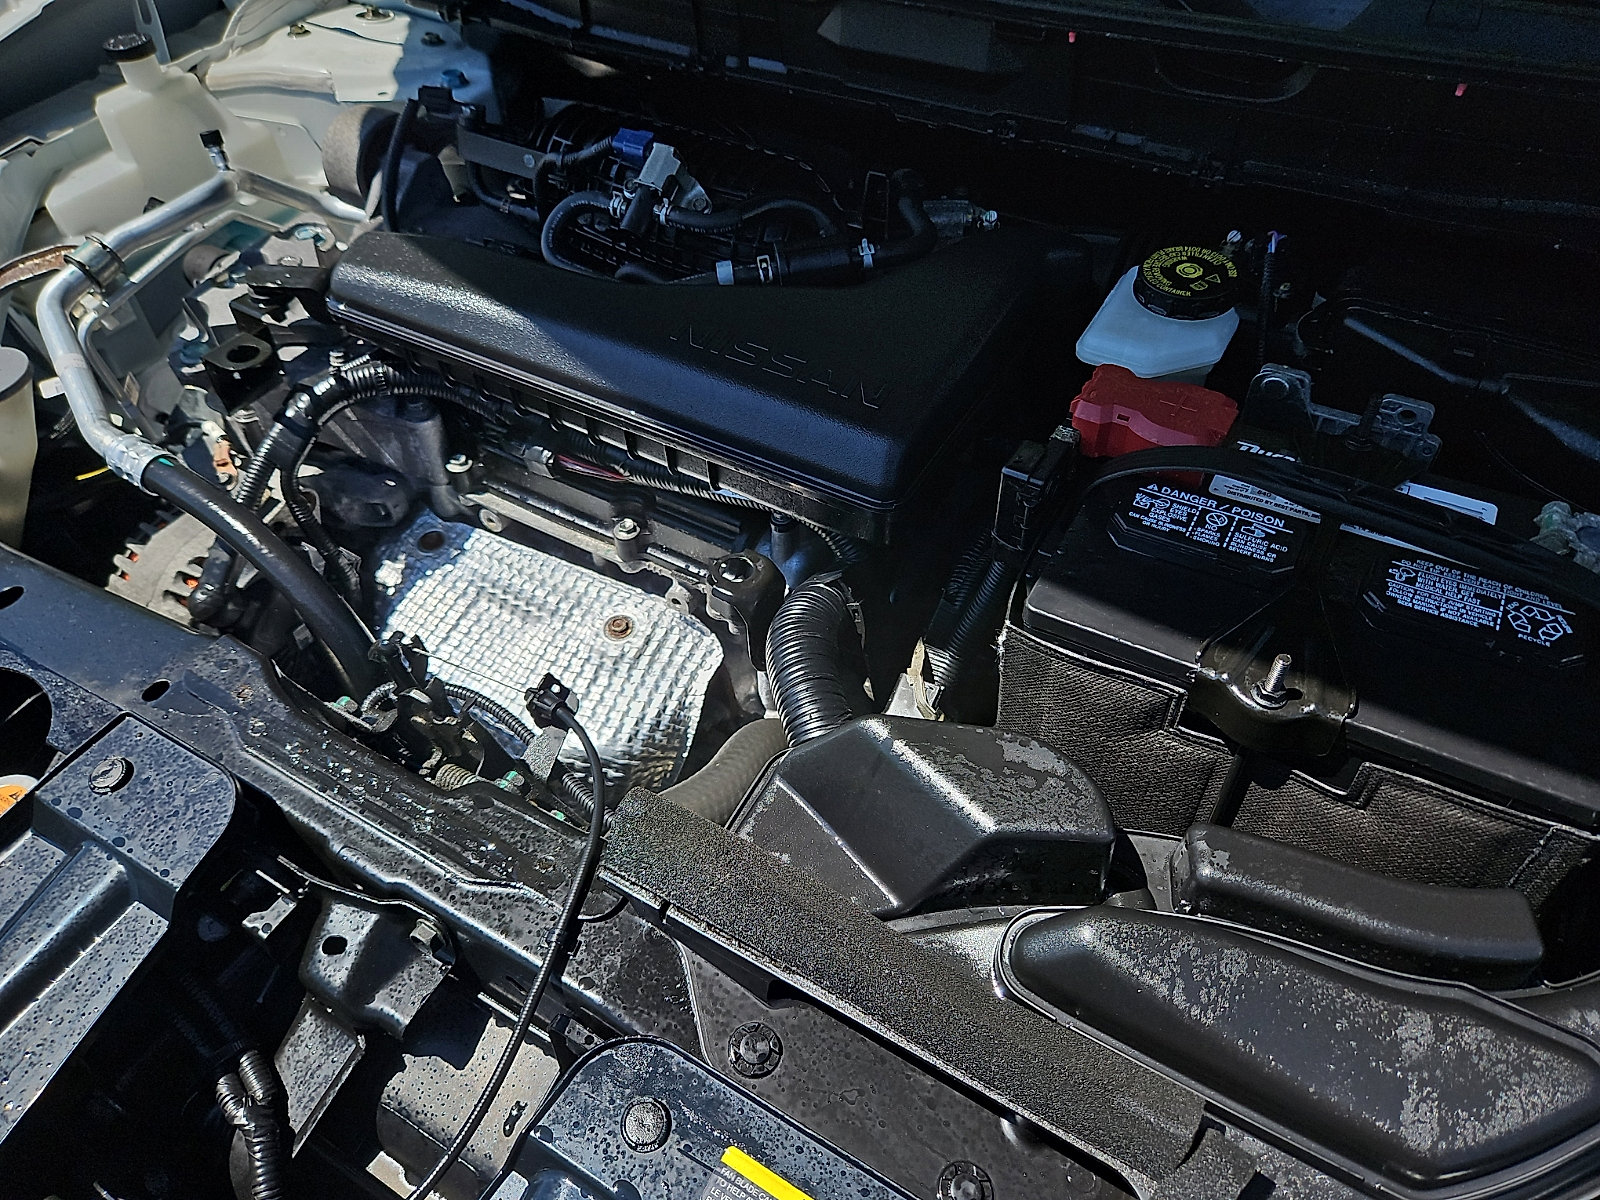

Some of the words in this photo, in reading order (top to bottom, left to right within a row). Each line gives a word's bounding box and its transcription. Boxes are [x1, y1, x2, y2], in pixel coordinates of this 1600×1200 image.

[1156, 283, 1192, 297] CONTAINER
[1161, 486, 1218, 508] DANGER
[1232, 506, 1285, 528] POISON
[1226, 490, 1264, 504] DISTRIBUTED
[1274, 502, 1288, 512] BEST
[1151, 507, 1188, 522] EXPLOSIVE
[1170, 508, 1188, 516] EYES
[1172, 502, 1196, 514] SHIELD
[1140, 515, 1157, 524] CAUSE
[1149, 512, 1170, 522] GASES
[1195, 532, 1218, 541] FLAMES
[1197, 527, 1220, 537] SPARKS
[1193, 535, 1220, 546] SMOKING
[1234, 532, 1269, 546] SULFURIC
[1270, 543, 1288, 552] ACID
[1247, 542, 1267, 551] CAUSE
[1228, 546, 1251, 556] SEVERE
[1418, 572, 1439, 581] FLUSH
[1441, 578, 1457, 586] EYES
[1459, 583, 1501, 600] IMMEDIATELY
[1418, 577, 1434, 586] WITH
[1461, 589, 1474, 597] GET
[1479, 576, 1501, 587] REACH
[1389, 587, 1413, 598] FOLLOW
[1416, 582, 1443, 594] MEDICAL
[1445, 590, 1462, 599] HELP
[1464, 596, 1480, 605] FAST
[1518, 633, 1551, 647] RECYCLE
[716, 1177, 726, 1187] TO
[727, 1184, 746, 1198] HELP
[721, 1167, 736, 1181] FAN
[735, 1177, 759, 1197] BLADE
